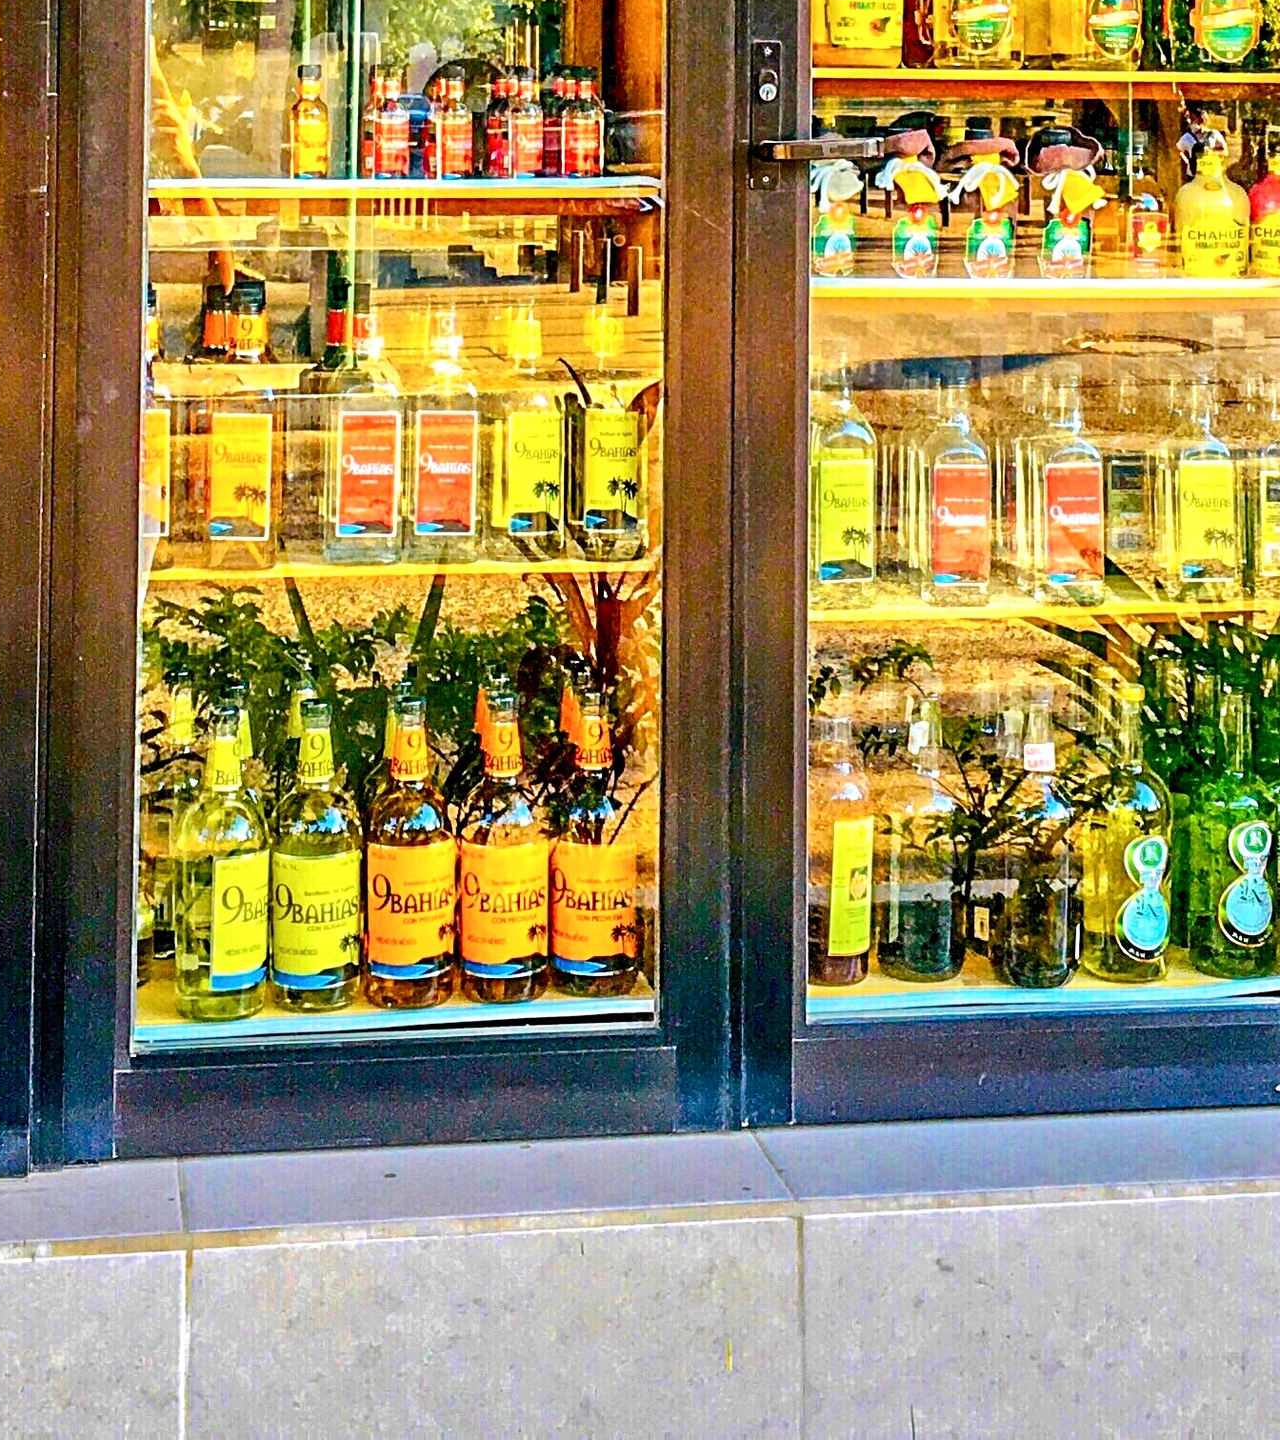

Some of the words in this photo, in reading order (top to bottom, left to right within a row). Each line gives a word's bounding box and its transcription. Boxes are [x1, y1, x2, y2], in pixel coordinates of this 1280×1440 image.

[1187, 228, 1245, 241] CHAHUE
[241, 318, 253, 336] 9
[406, 731, 422, 756] 9
[498, 728, 513, 753] 9
[588, 721, 604, 745] 9
[310, 733, 325, 760] 9
